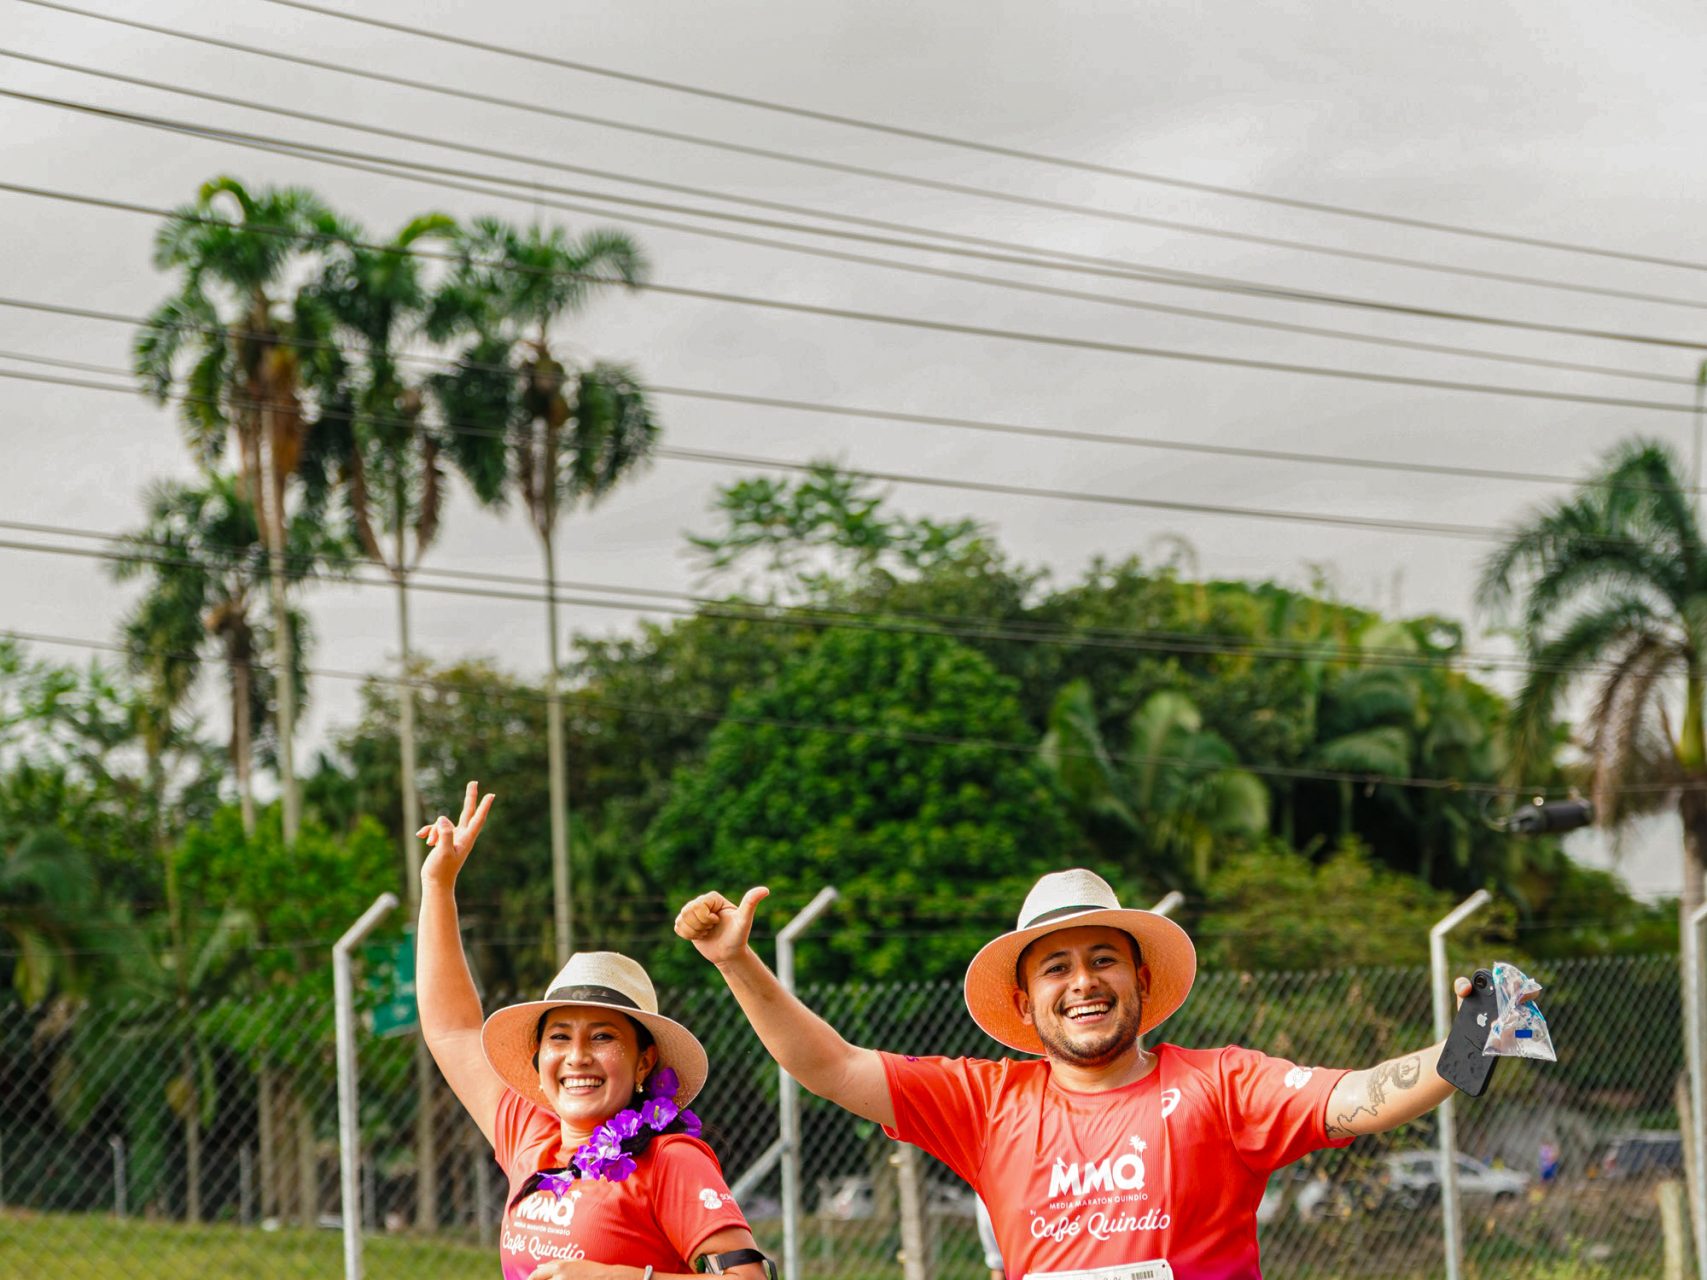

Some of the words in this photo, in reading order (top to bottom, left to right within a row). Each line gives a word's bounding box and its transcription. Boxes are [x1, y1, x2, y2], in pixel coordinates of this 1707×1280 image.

[1048, 1154, 1145, 1198] MMQ
[516, 1195, 575, 1227] MMQ
[1049, 1201, 1074, 1210] MEDIA
[1114, 1193, 1149, 1204] QUINDÍO
[1030, 1215, 1081, 1242] Café
[1087, 1208, 1171, 1240] Quindío
[502, 1231, 527, 1256] Café
[528, 1236, 585, 1261] Quindío
